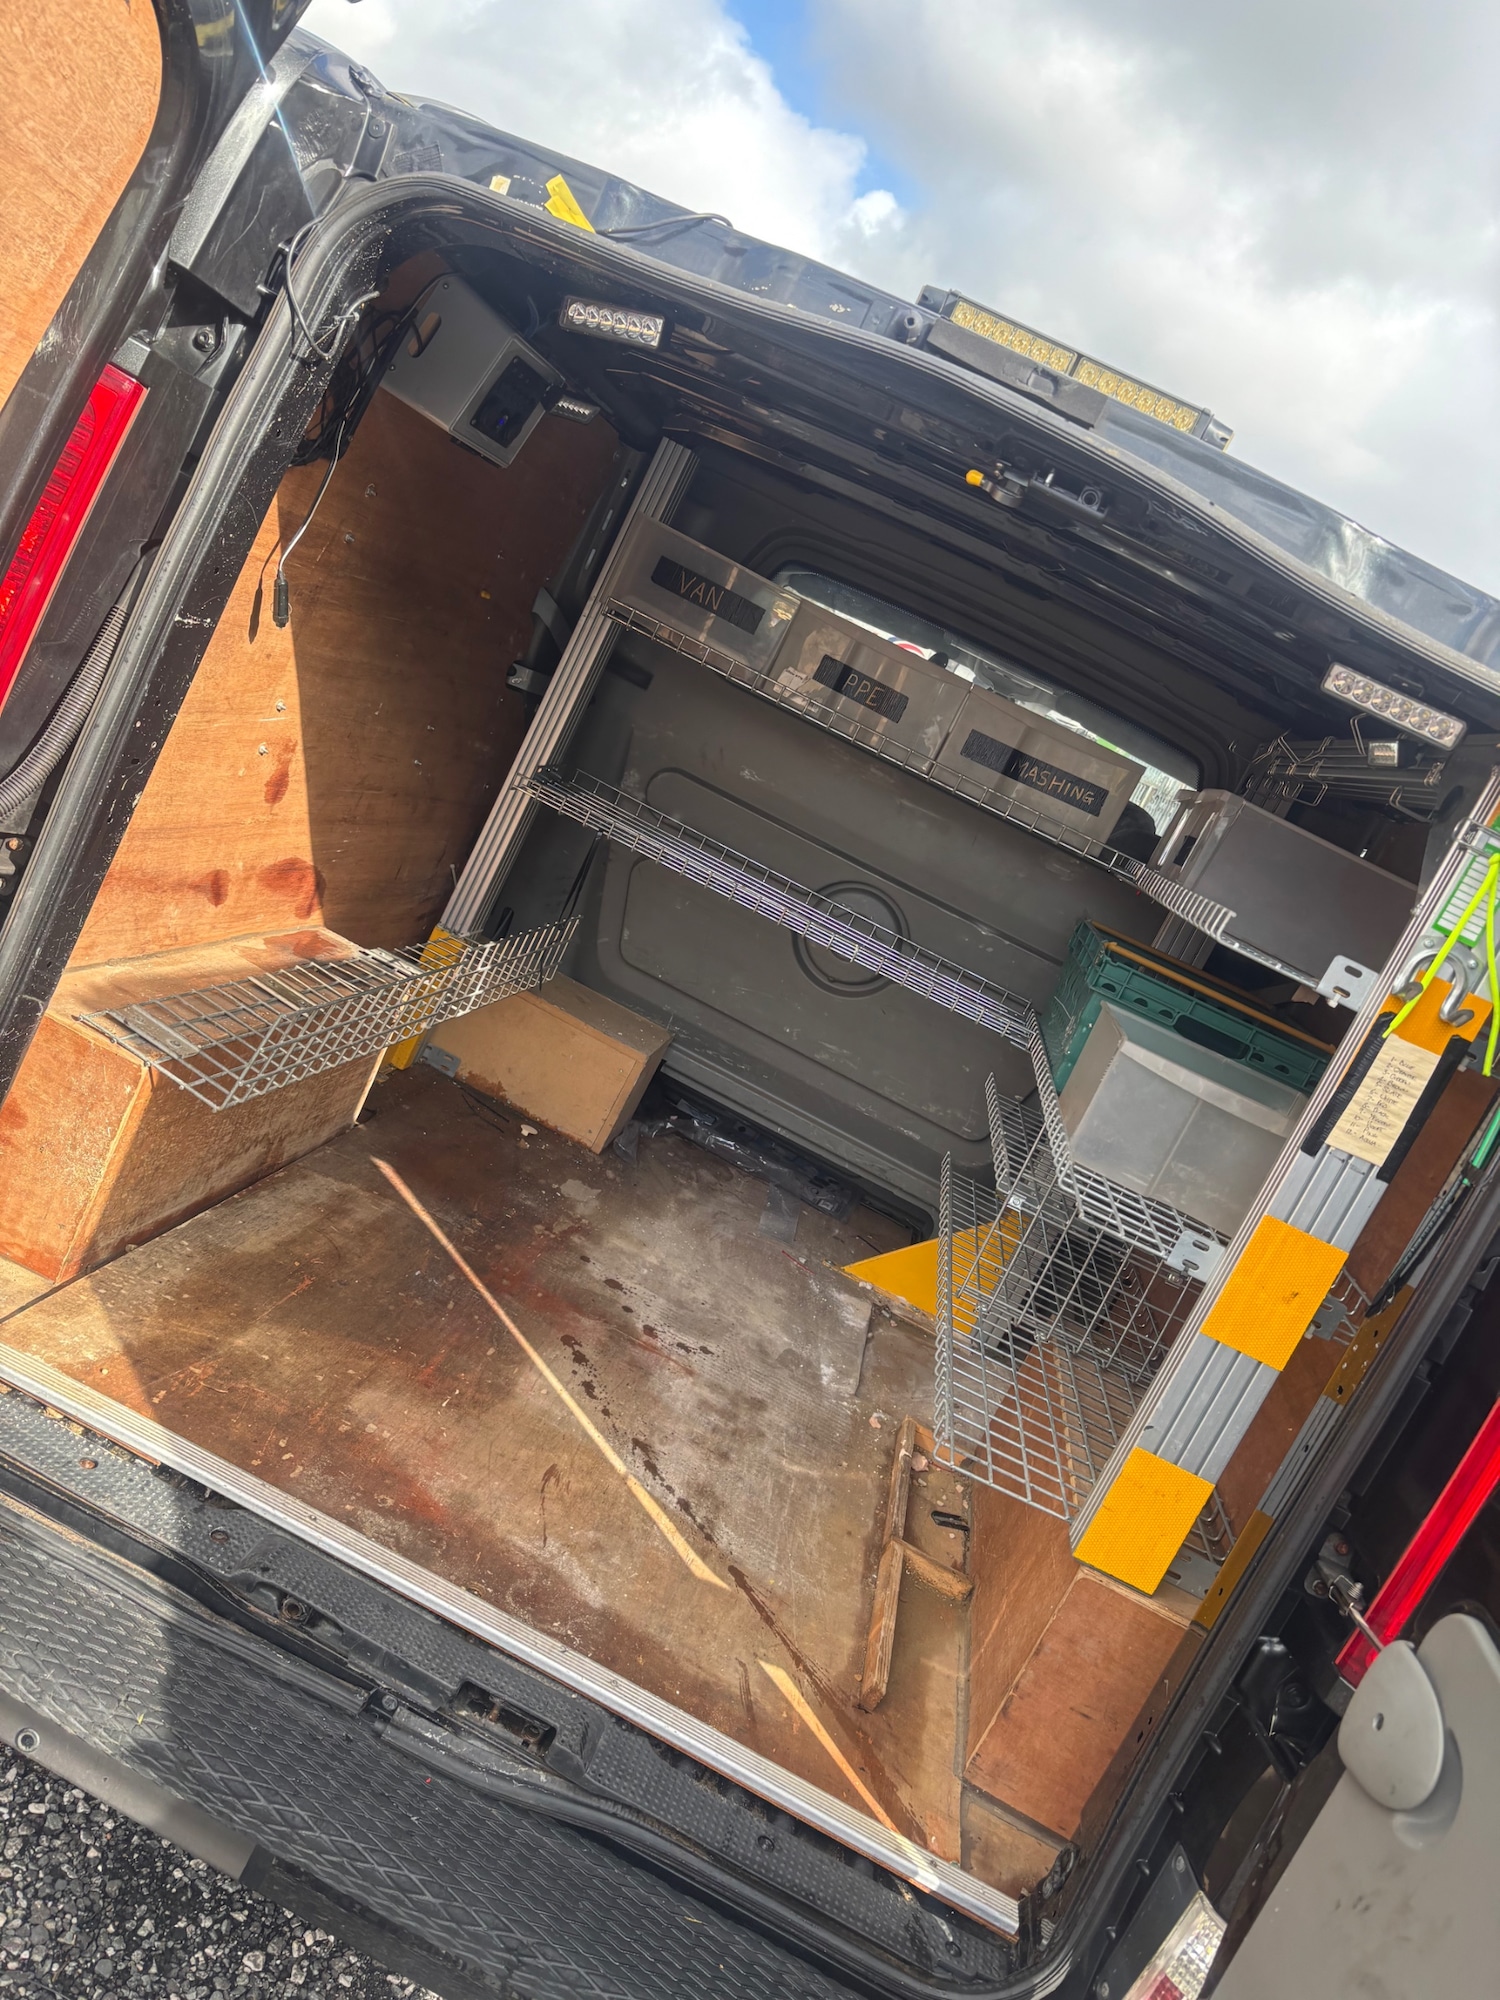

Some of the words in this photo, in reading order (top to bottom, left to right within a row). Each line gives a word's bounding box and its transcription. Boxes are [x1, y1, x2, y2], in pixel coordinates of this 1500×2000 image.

[679, 570, 725, 610] VAN
[841, 673, 885, 706] PPE
[1009, 758, 1095, 806] MASHING
